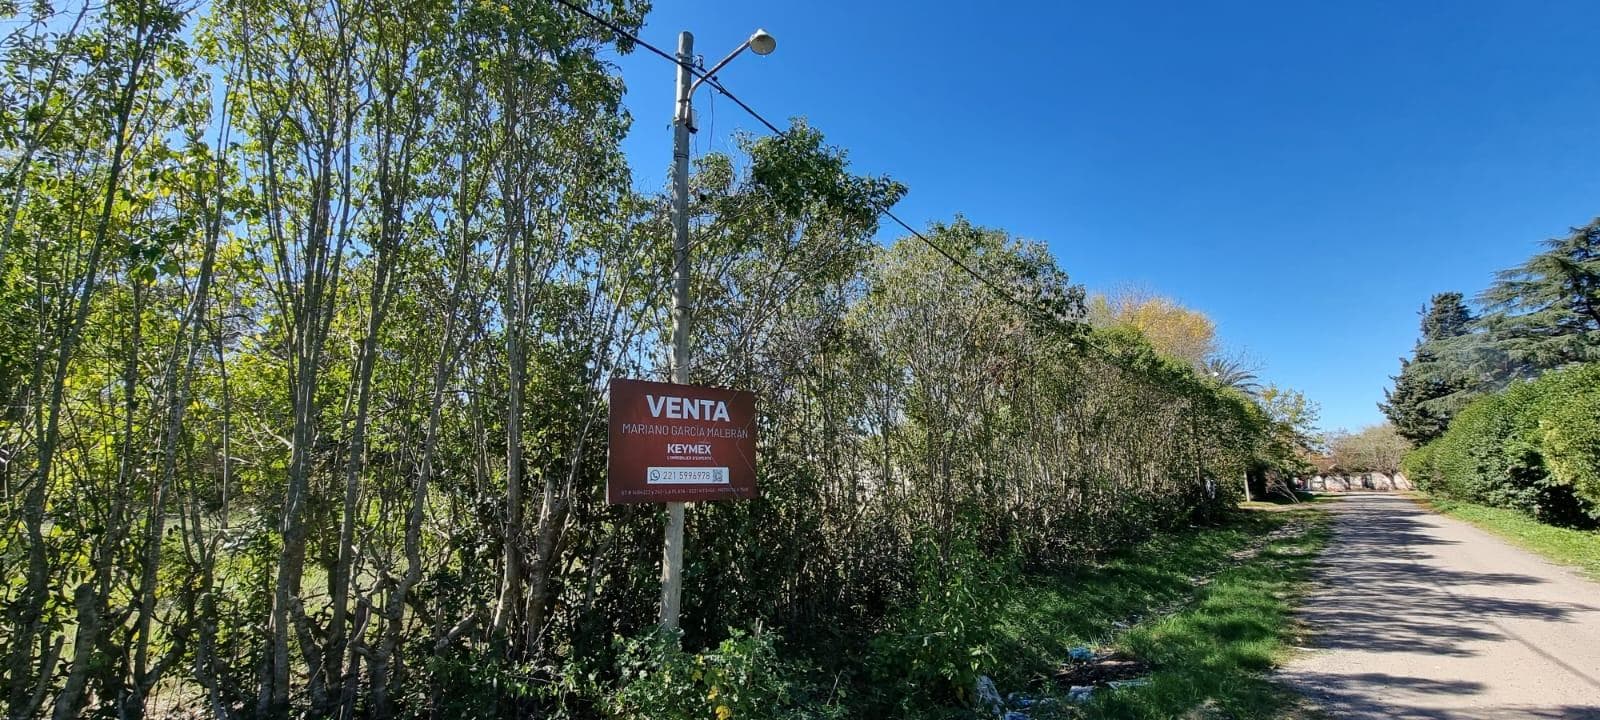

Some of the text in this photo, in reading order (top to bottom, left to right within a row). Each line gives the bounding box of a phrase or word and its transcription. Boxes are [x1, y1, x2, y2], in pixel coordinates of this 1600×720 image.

[646, 395, 730, 422] VENTA
[622, 423, 669, 435] MARIANO
[667, 443, 711, 455] KEYMEX
[663, 471, 676, 480] 221
